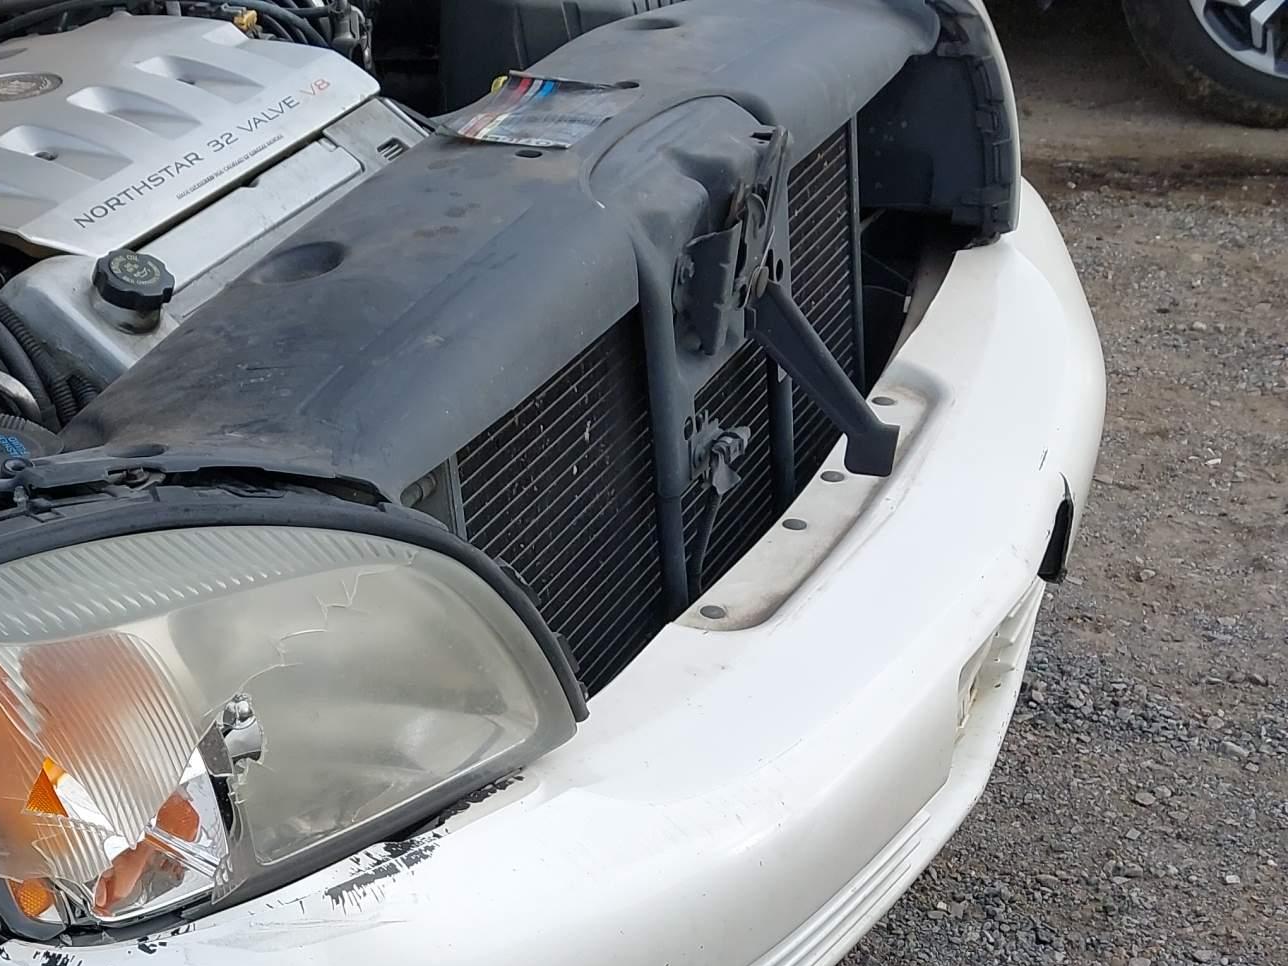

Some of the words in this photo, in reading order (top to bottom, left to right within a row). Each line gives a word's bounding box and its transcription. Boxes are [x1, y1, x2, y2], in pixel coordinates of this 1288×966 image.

[73, 151, 205, 229] NORTHSTAR
[206, 131, 240, 154] 32
[236, 95, 301, 133] VALVE
[299, 78, 331, 96] V8
